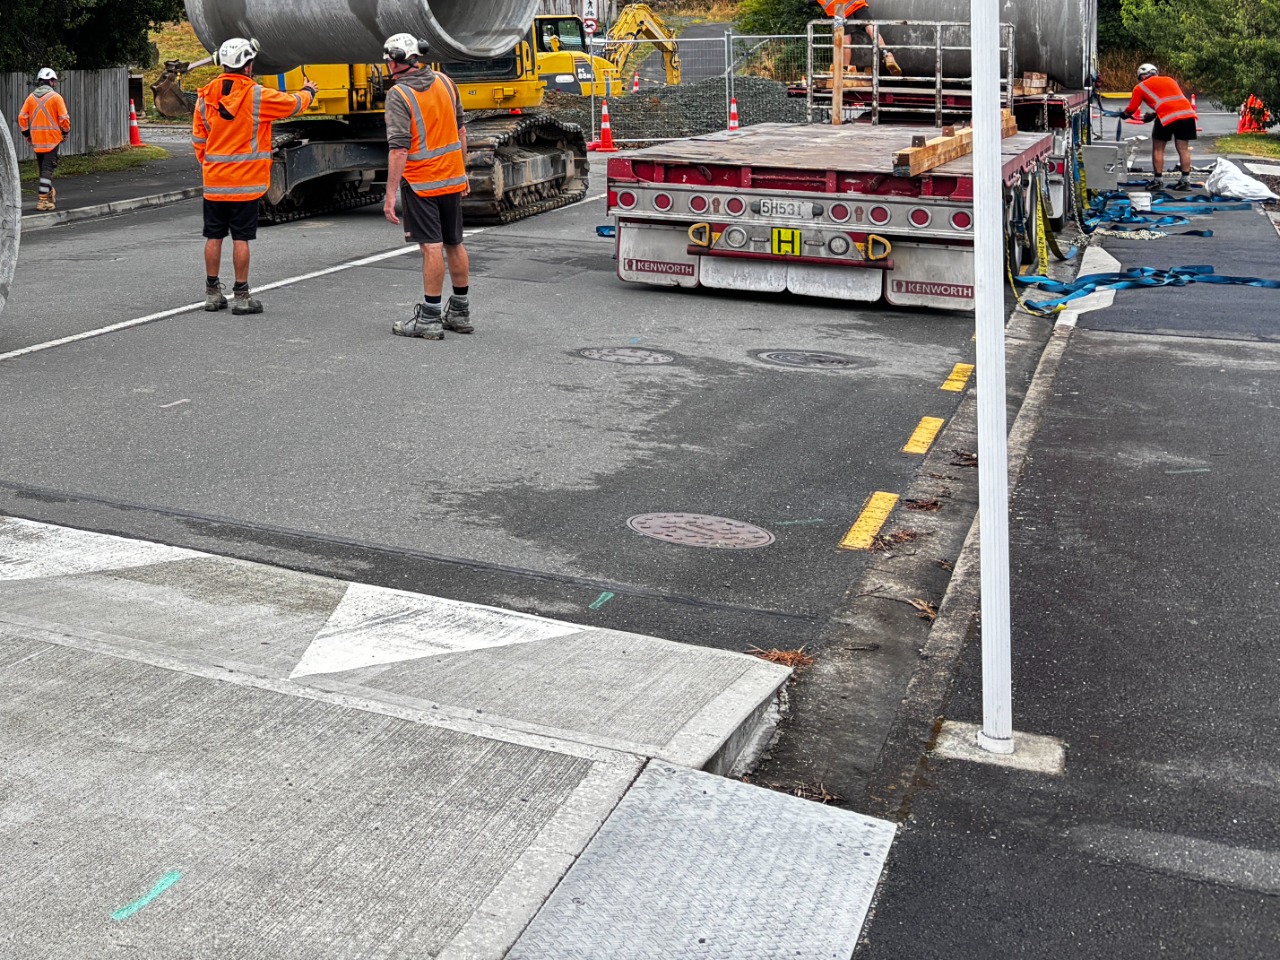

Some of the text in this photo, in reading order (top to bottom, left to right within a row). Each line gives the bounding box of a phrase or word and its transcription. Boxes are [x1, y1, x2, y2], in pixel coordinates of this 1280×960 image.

[762, 201, 802, 216] 5H531
[777, 229, 795, 254] H
[637, 261, 693, 275] KENWORTH
[908, 283, 972, 297] KENWORTH
